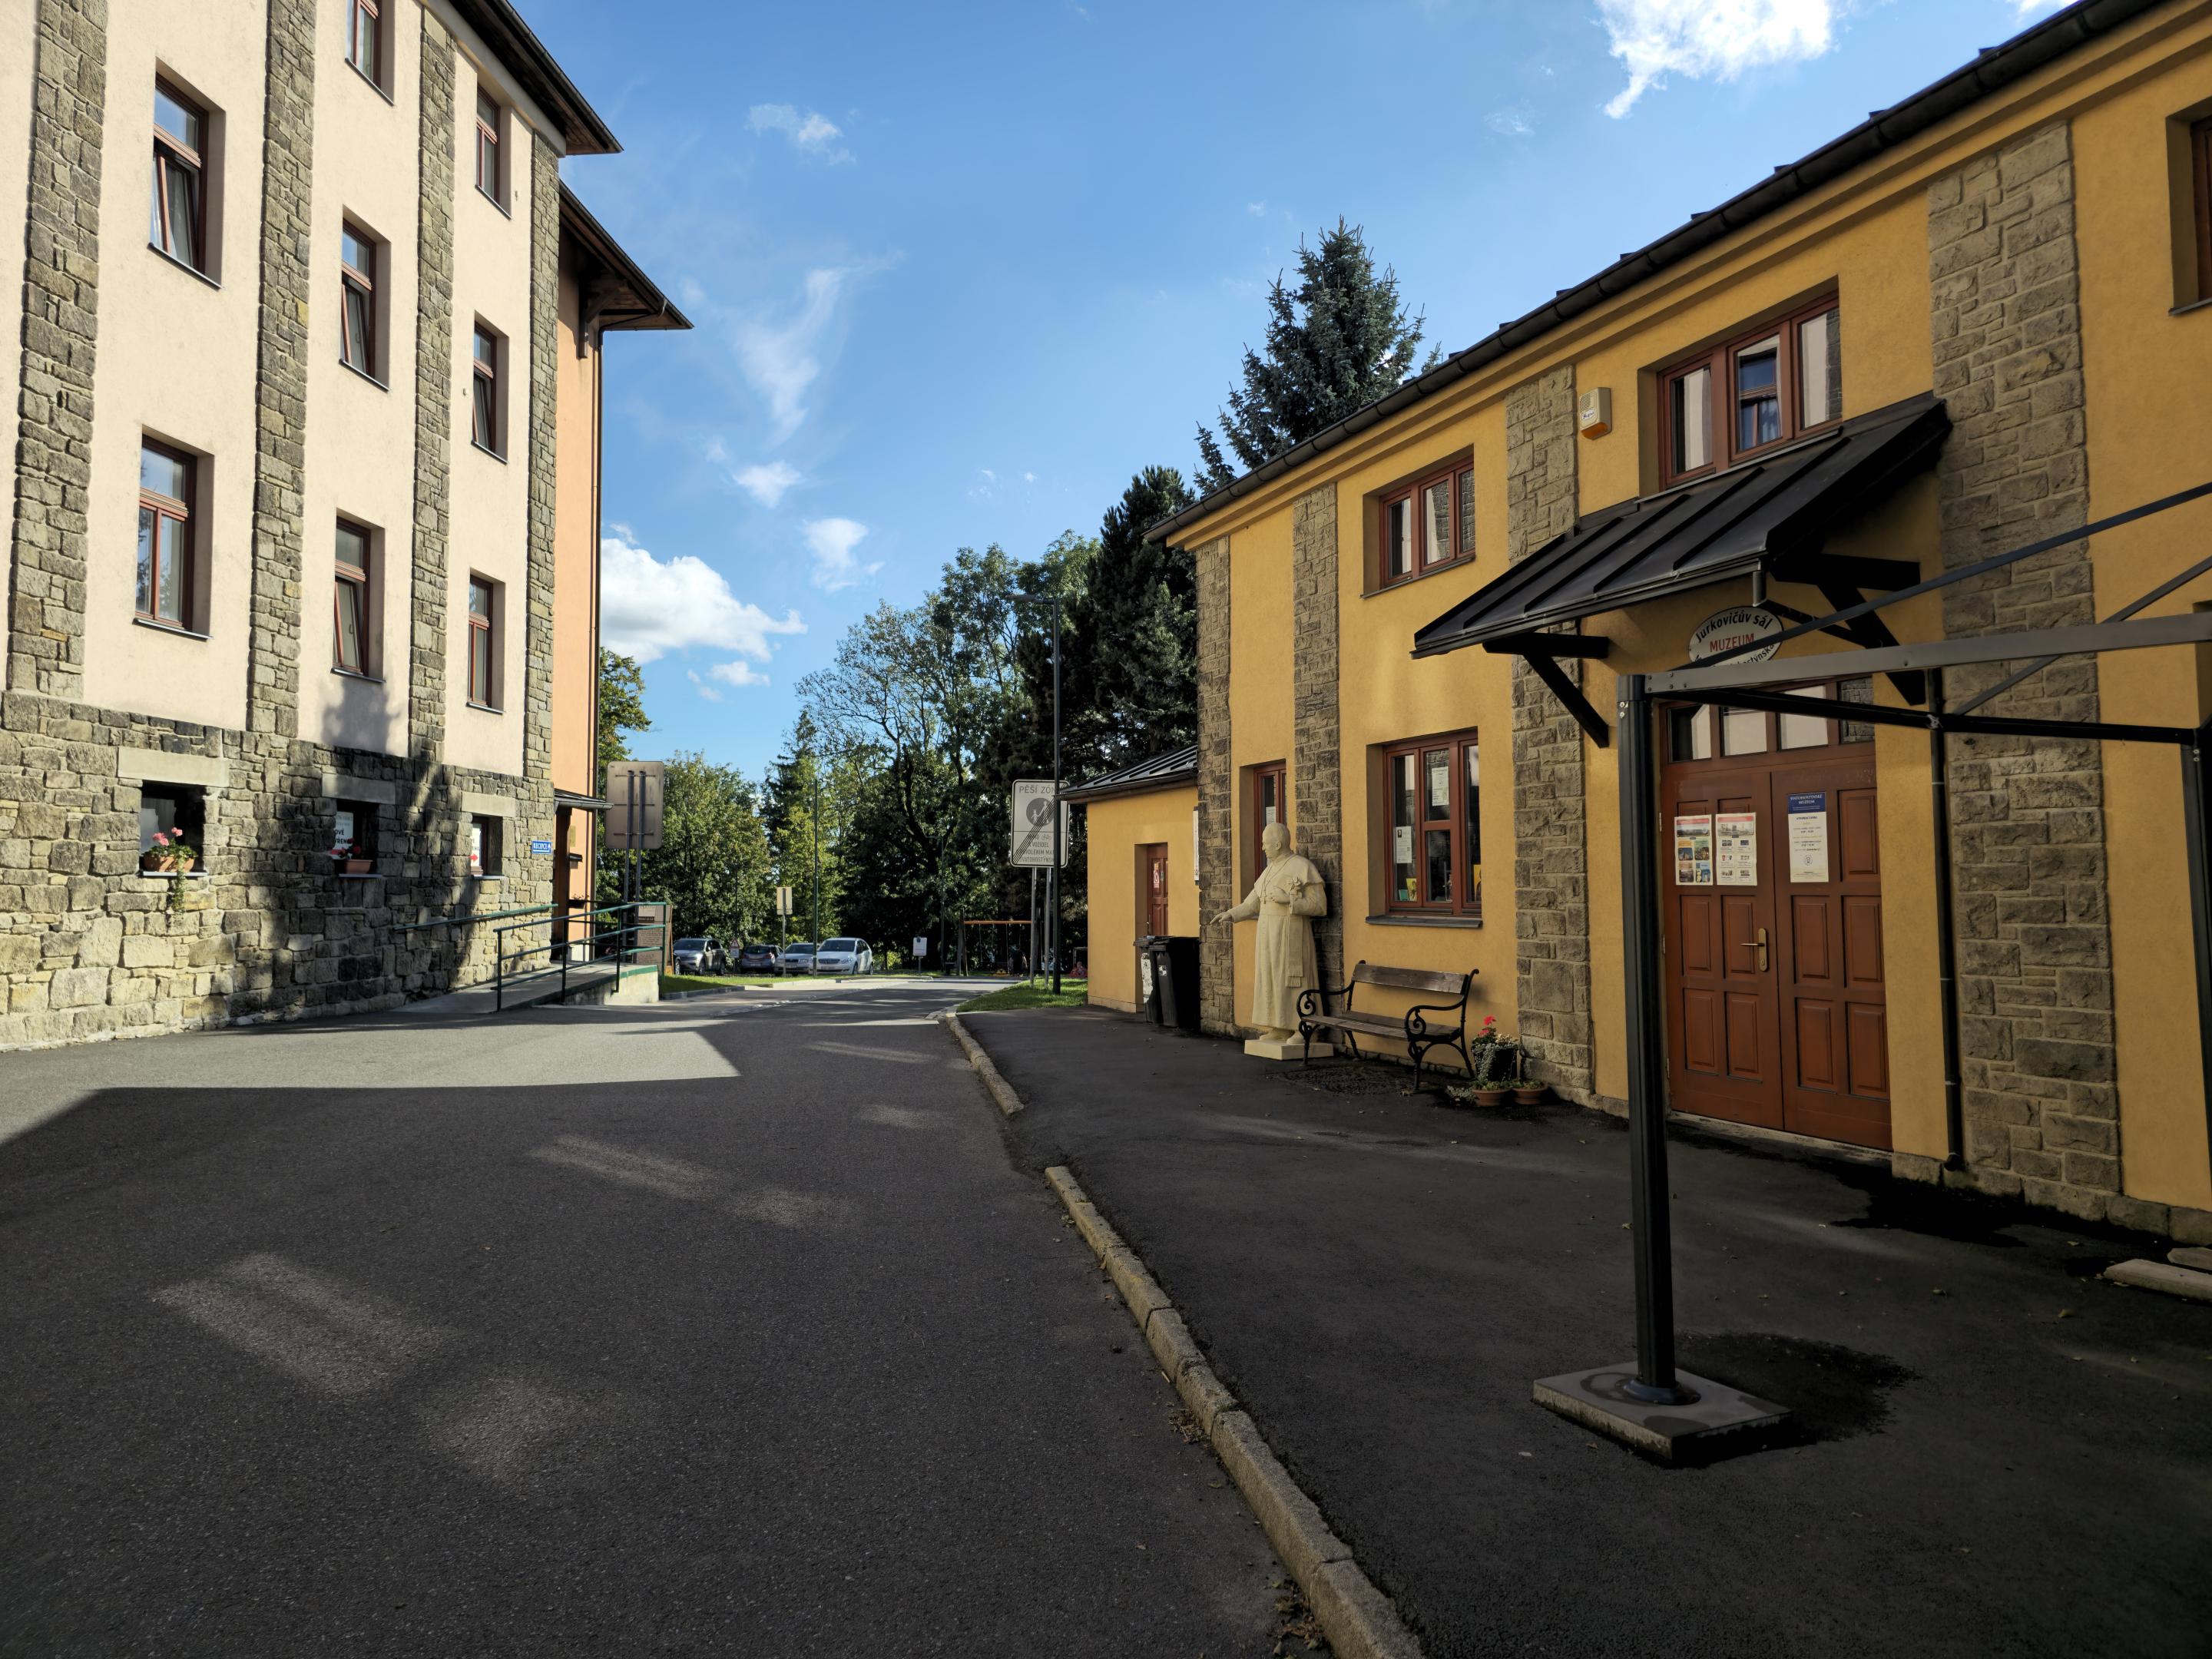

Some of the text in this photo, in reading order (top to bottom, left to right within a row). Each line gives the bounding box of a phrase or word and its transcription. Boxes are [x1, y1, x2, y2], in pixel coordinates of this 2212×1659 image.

[1695, 610, 1773, 643] Jurkovičův sál
[1710, 633, 1755, 652] MUZEUM
[1019, 784, 1055, 794] PĚŠÍ ZÓN
